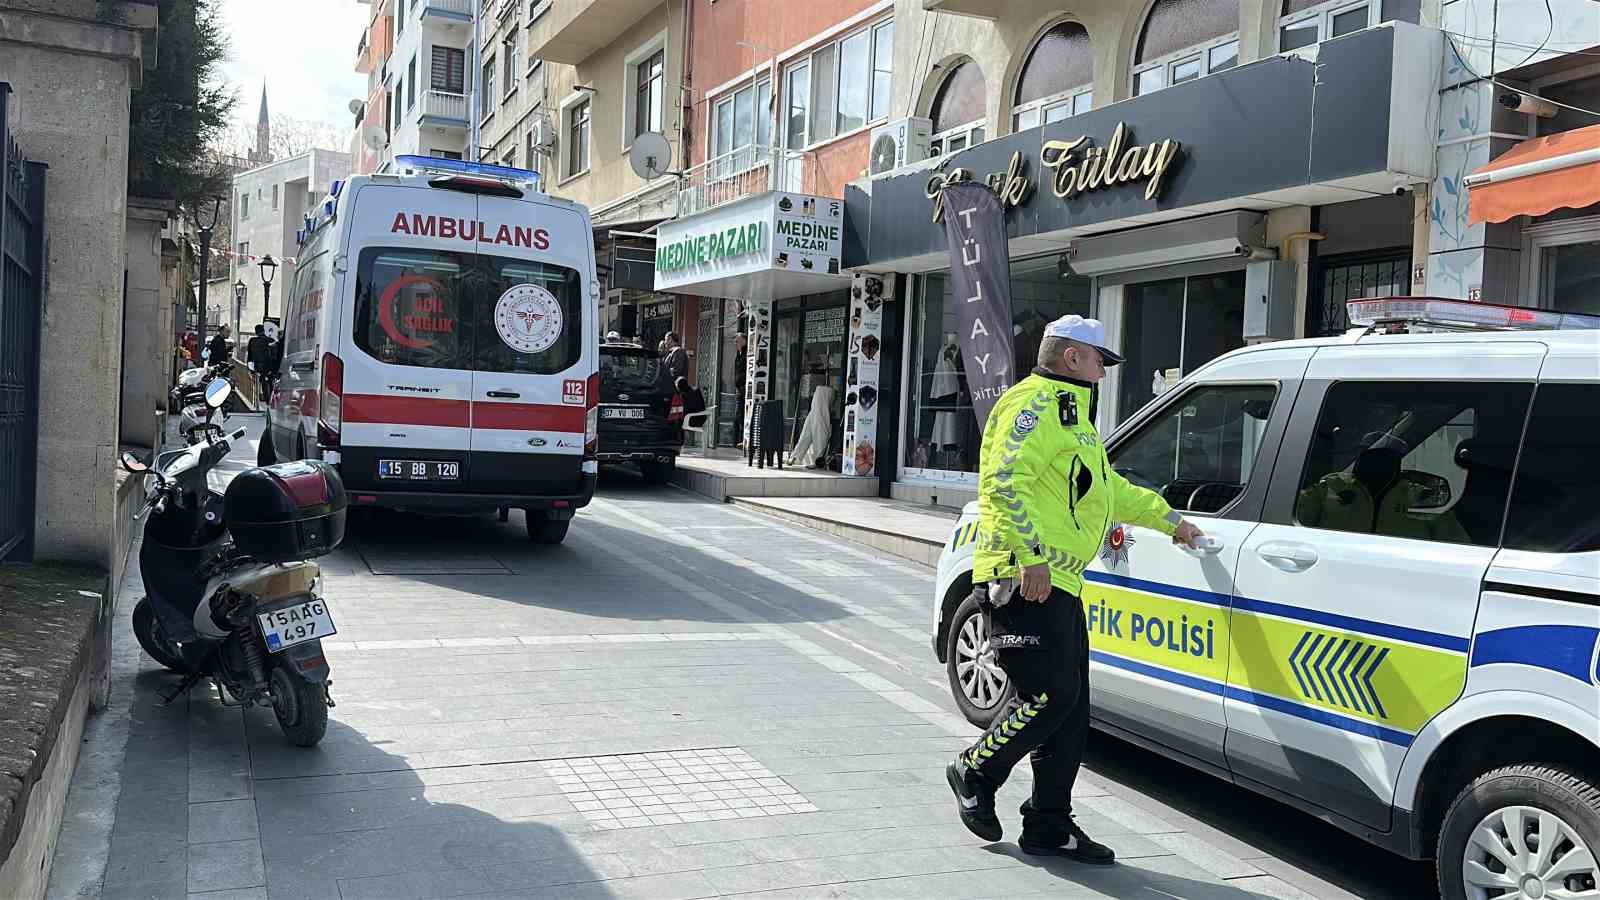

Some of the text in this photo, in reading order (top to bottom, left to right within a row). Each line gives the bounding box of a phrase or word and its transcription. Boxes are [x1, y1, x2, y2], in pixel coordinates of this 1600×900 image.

[1041, 120, 1179, 201] Tülay
[391, 212, 550, 250] AMBULANS
[777, 220, 839, 241] MEDİNE
[656, 221, 762, 271] MEDİNE PAZARI
[787, 236, 828, 252] PAZARI
[388, 385, 441, 393] TRANSIT
[565, 382, 583, 395] 112
[388, 462, 457, 476] 15 BB 120
[284, 622, 316, 641] 497
[1087, 598, 1214, 660] FİK POLİSİ
